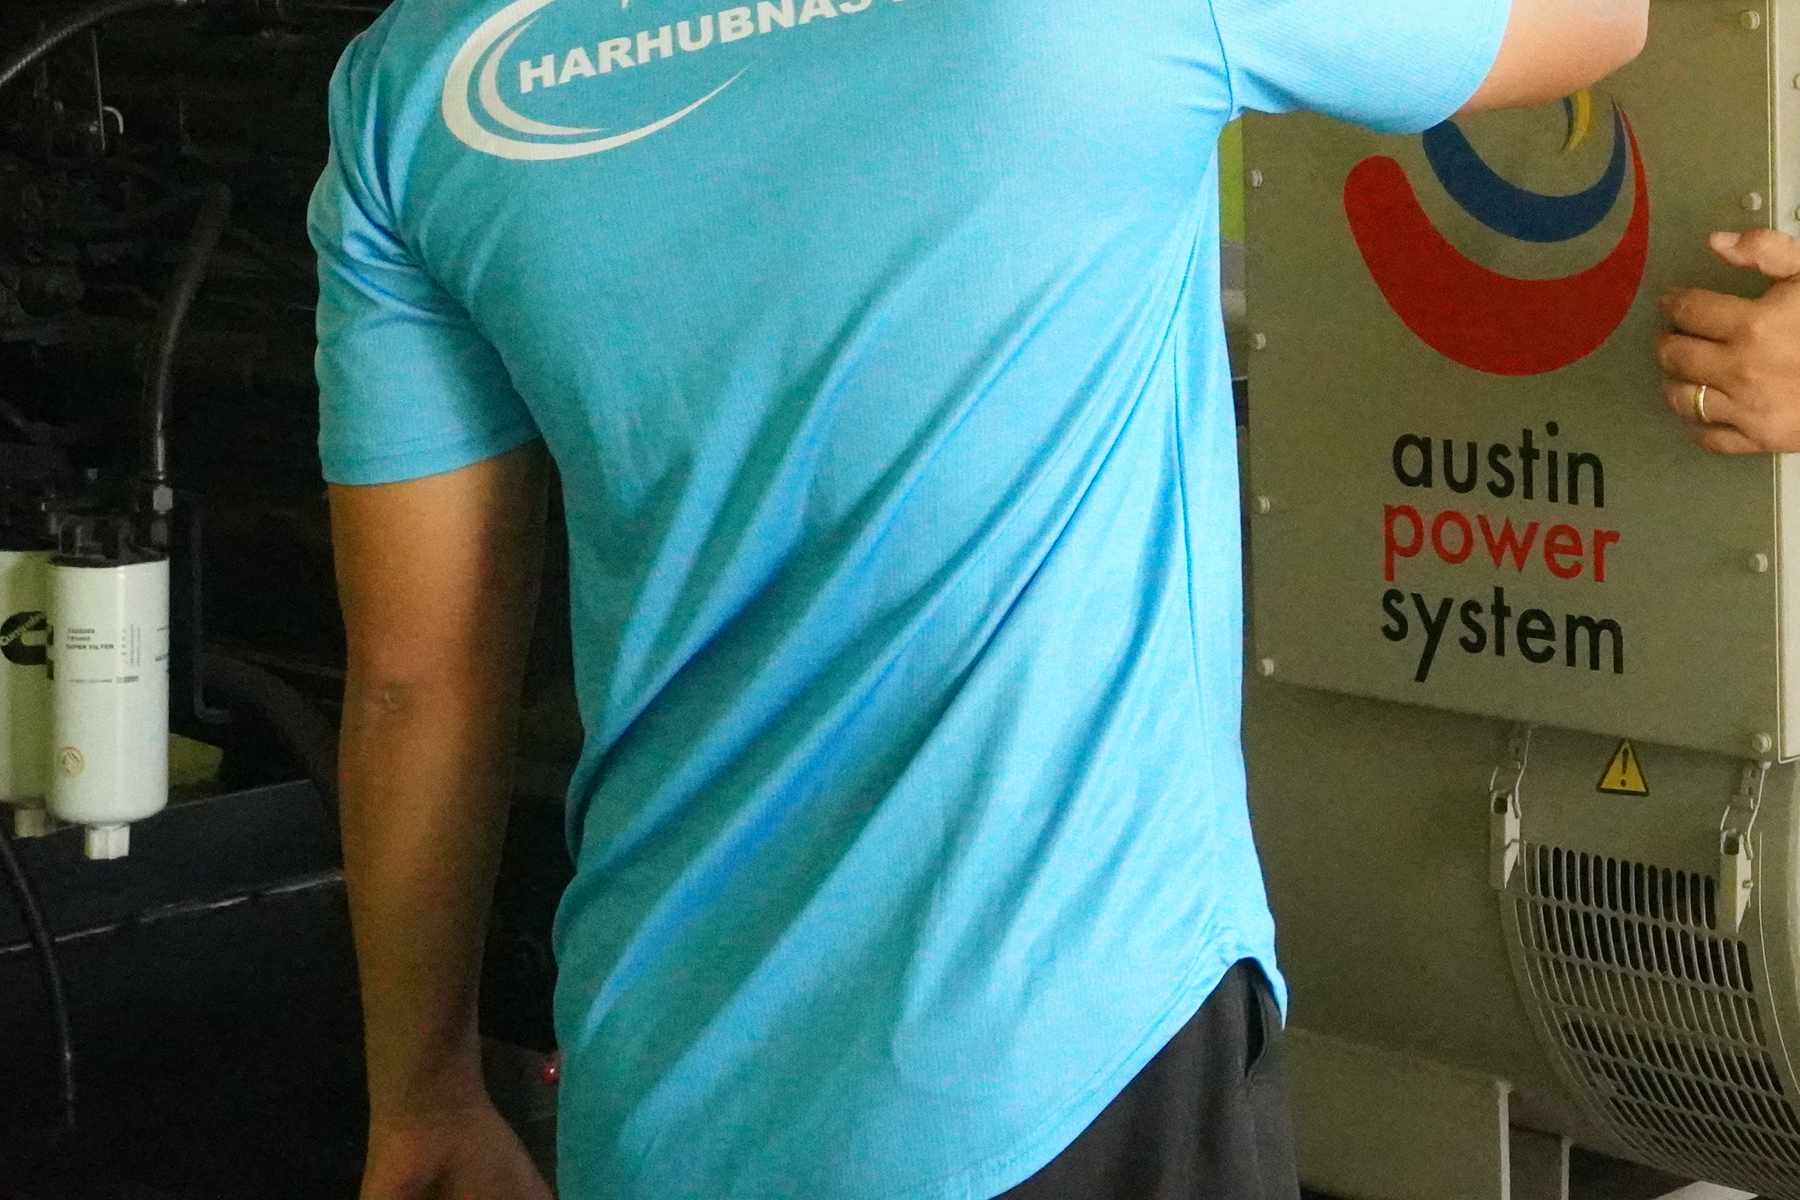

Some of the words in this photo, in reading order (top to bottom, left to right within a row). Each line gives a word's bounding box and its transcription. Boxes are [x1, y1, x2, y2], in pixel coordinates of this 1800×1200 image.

[1392, 420, 1605, 509] austin
[1382, 503, 1621, 583] power
[1380, 586, 1624, 683] system
